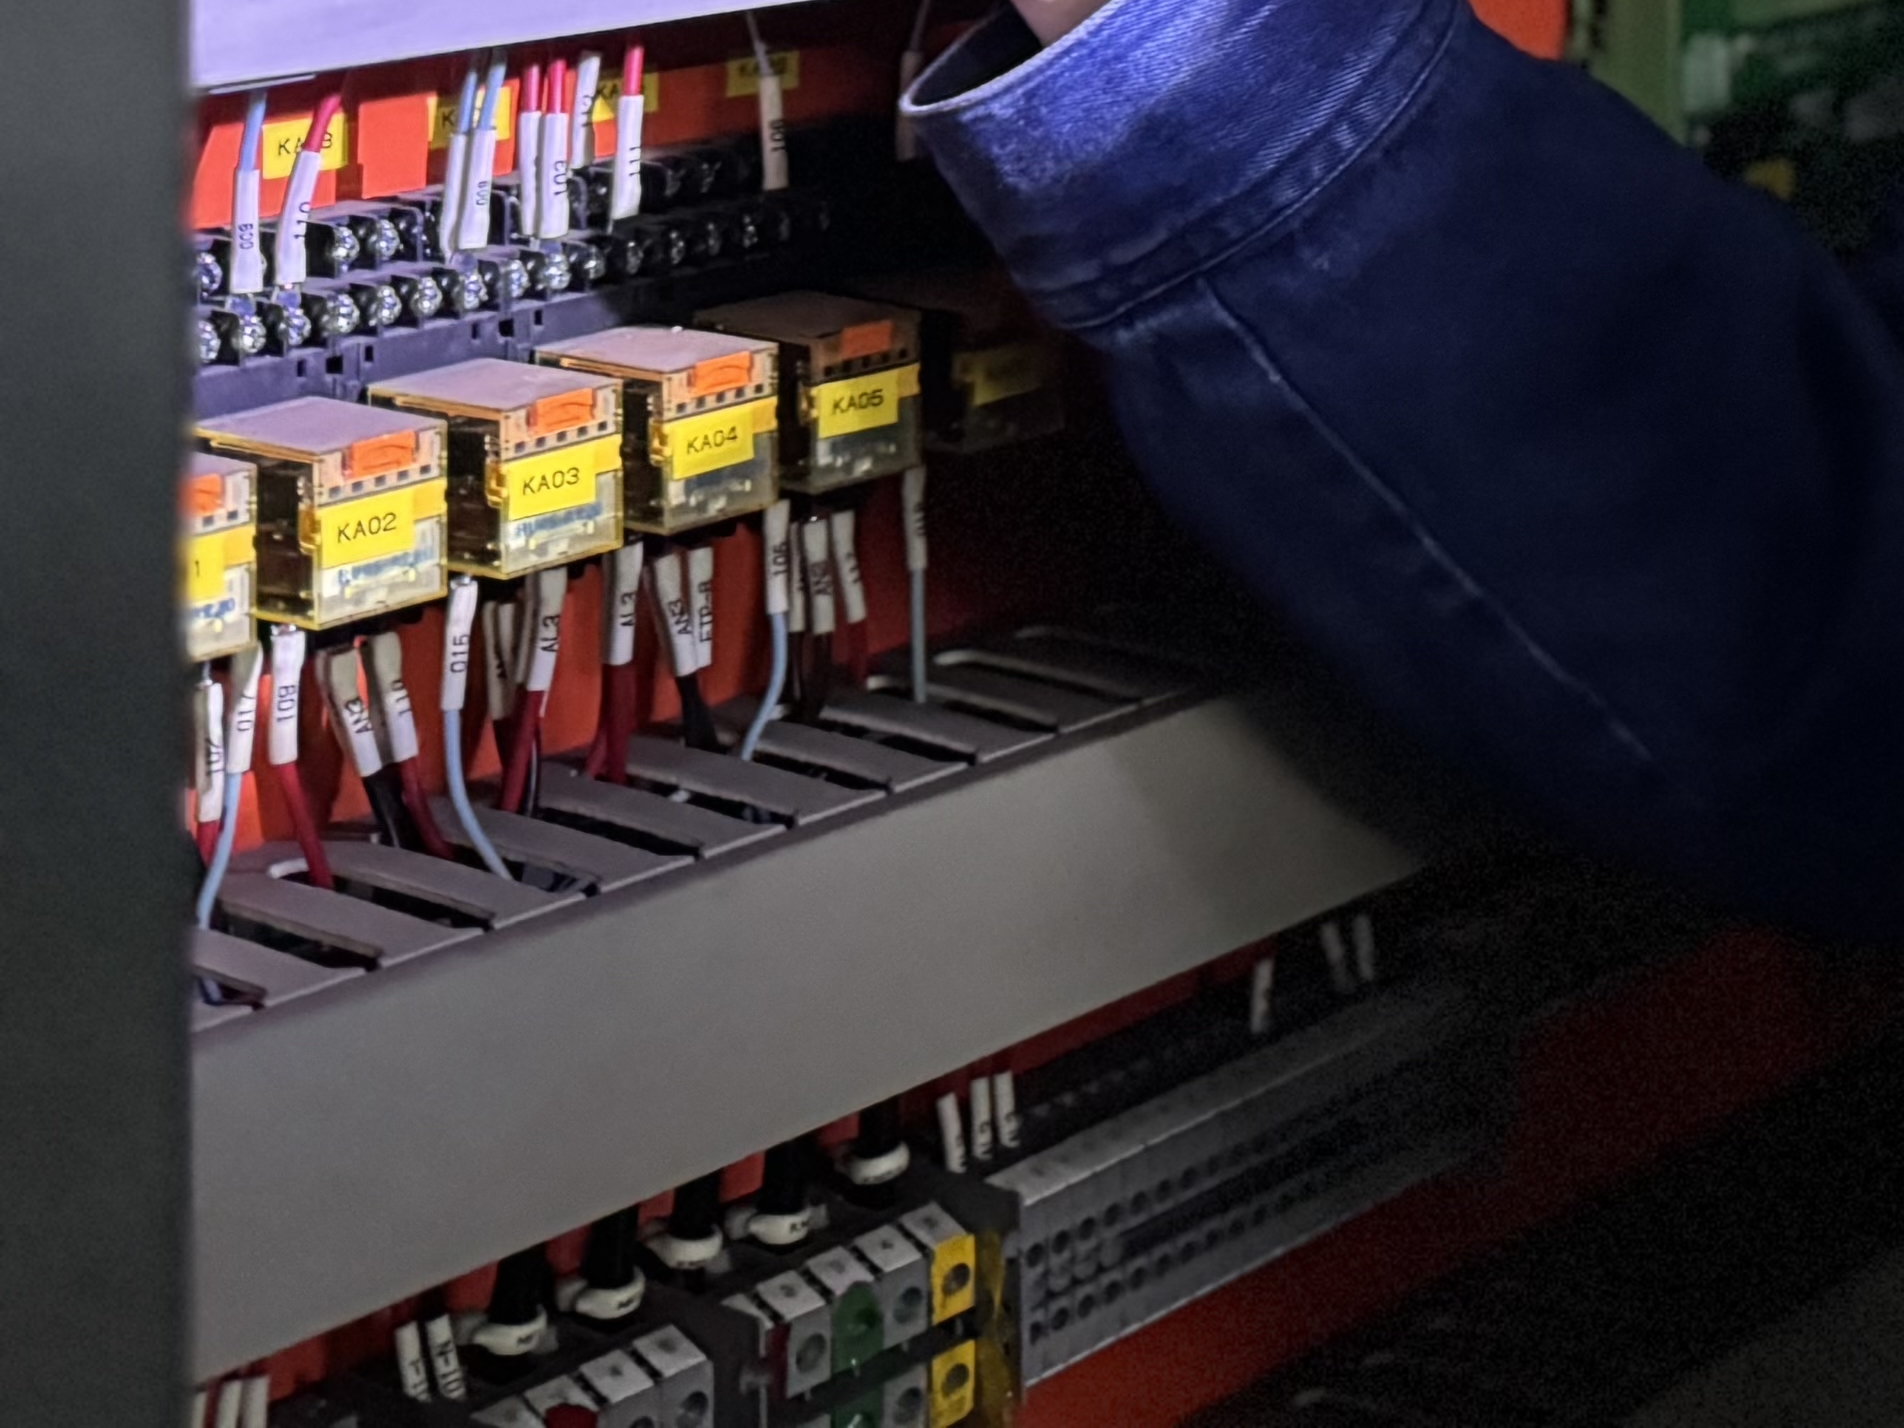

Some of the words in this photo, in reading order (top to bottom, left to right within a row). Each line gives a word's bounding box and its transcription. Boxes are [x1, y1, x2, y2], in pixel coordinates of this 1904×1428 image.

[831, 388, 885, 416] KA05
[686, 425, 739, 457] KA04
[522, 466, 581, 497] KA03
[336, 511, 398, 545] KA02
